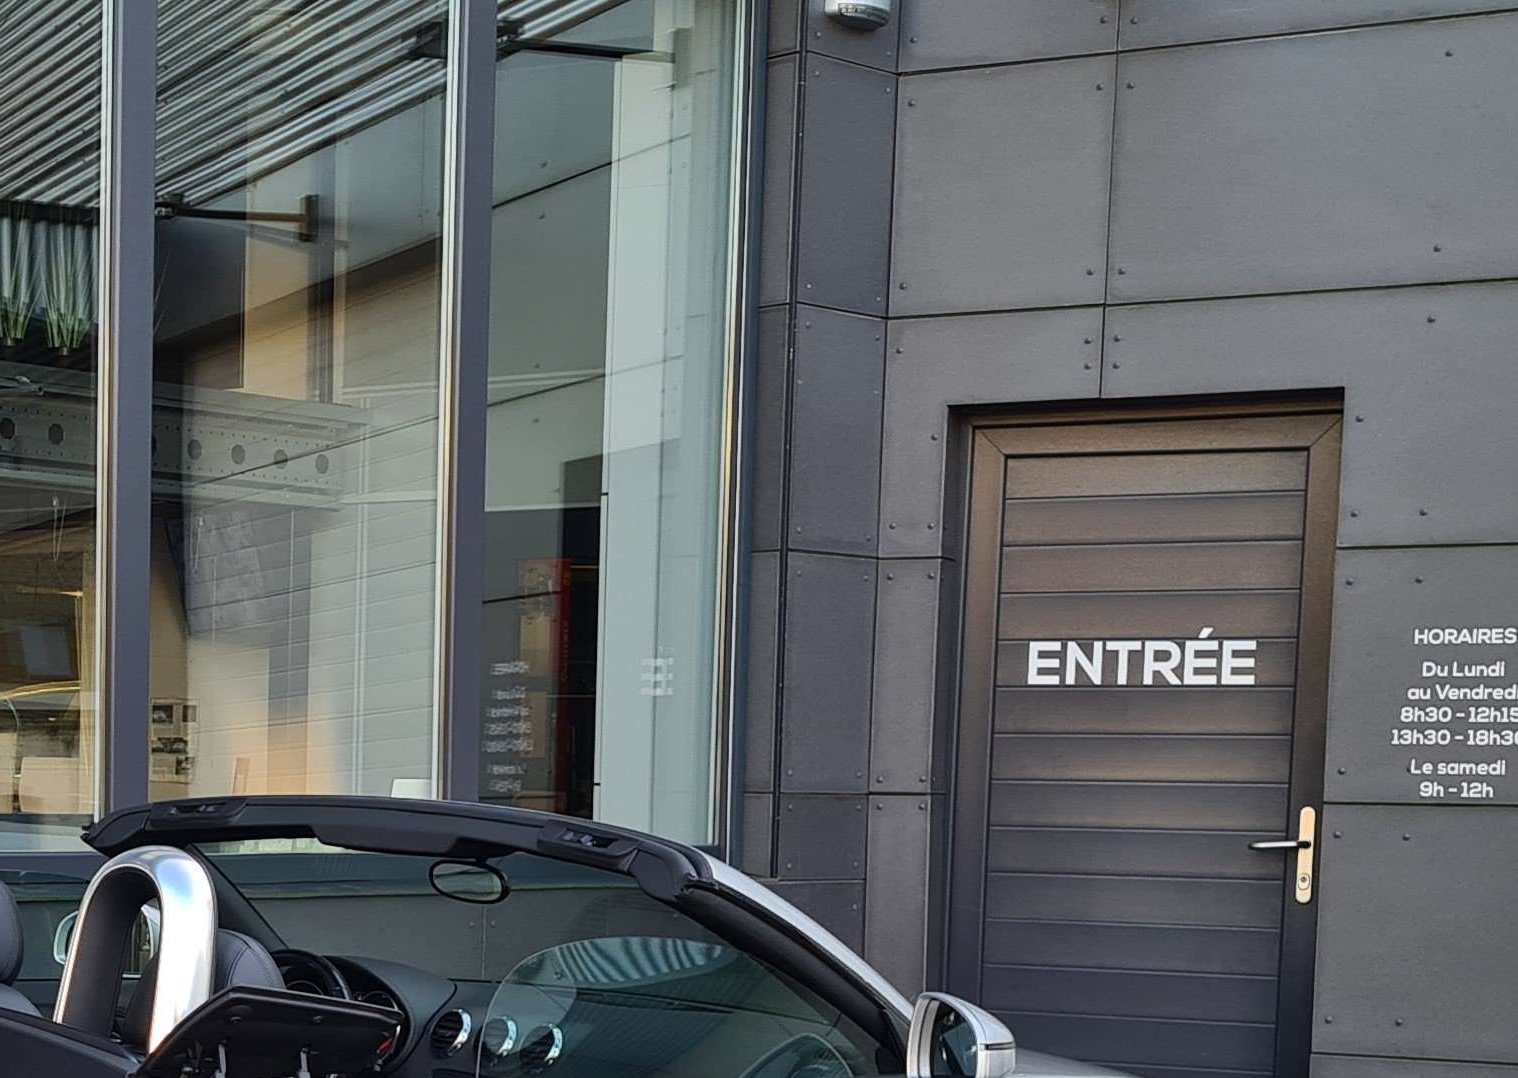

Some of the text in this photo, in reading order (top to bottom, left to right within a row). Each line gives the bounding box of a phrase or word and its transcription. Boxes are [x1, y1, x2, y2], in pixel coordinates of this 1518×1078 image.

[1413, 628, 1518, 645] HORAIRES
[1027, 626, 1257, 686] ENTRÉE
[1422, 661, 1506, 677] Du Lundi
[1407, 687, 1431, 700] au
[1400, 706, 1453, 723] 8h30
[1468, 706, 1518, 723] 12h15
[1391, 729, 1451, 745] 13h30
[1466, 729, 1518, 746] 18h3
[1410, 759, 1506, 775] Le samedi
[1419, 781, 1444, 798] 9h
[1460, 782, 1494, 798] 12h
